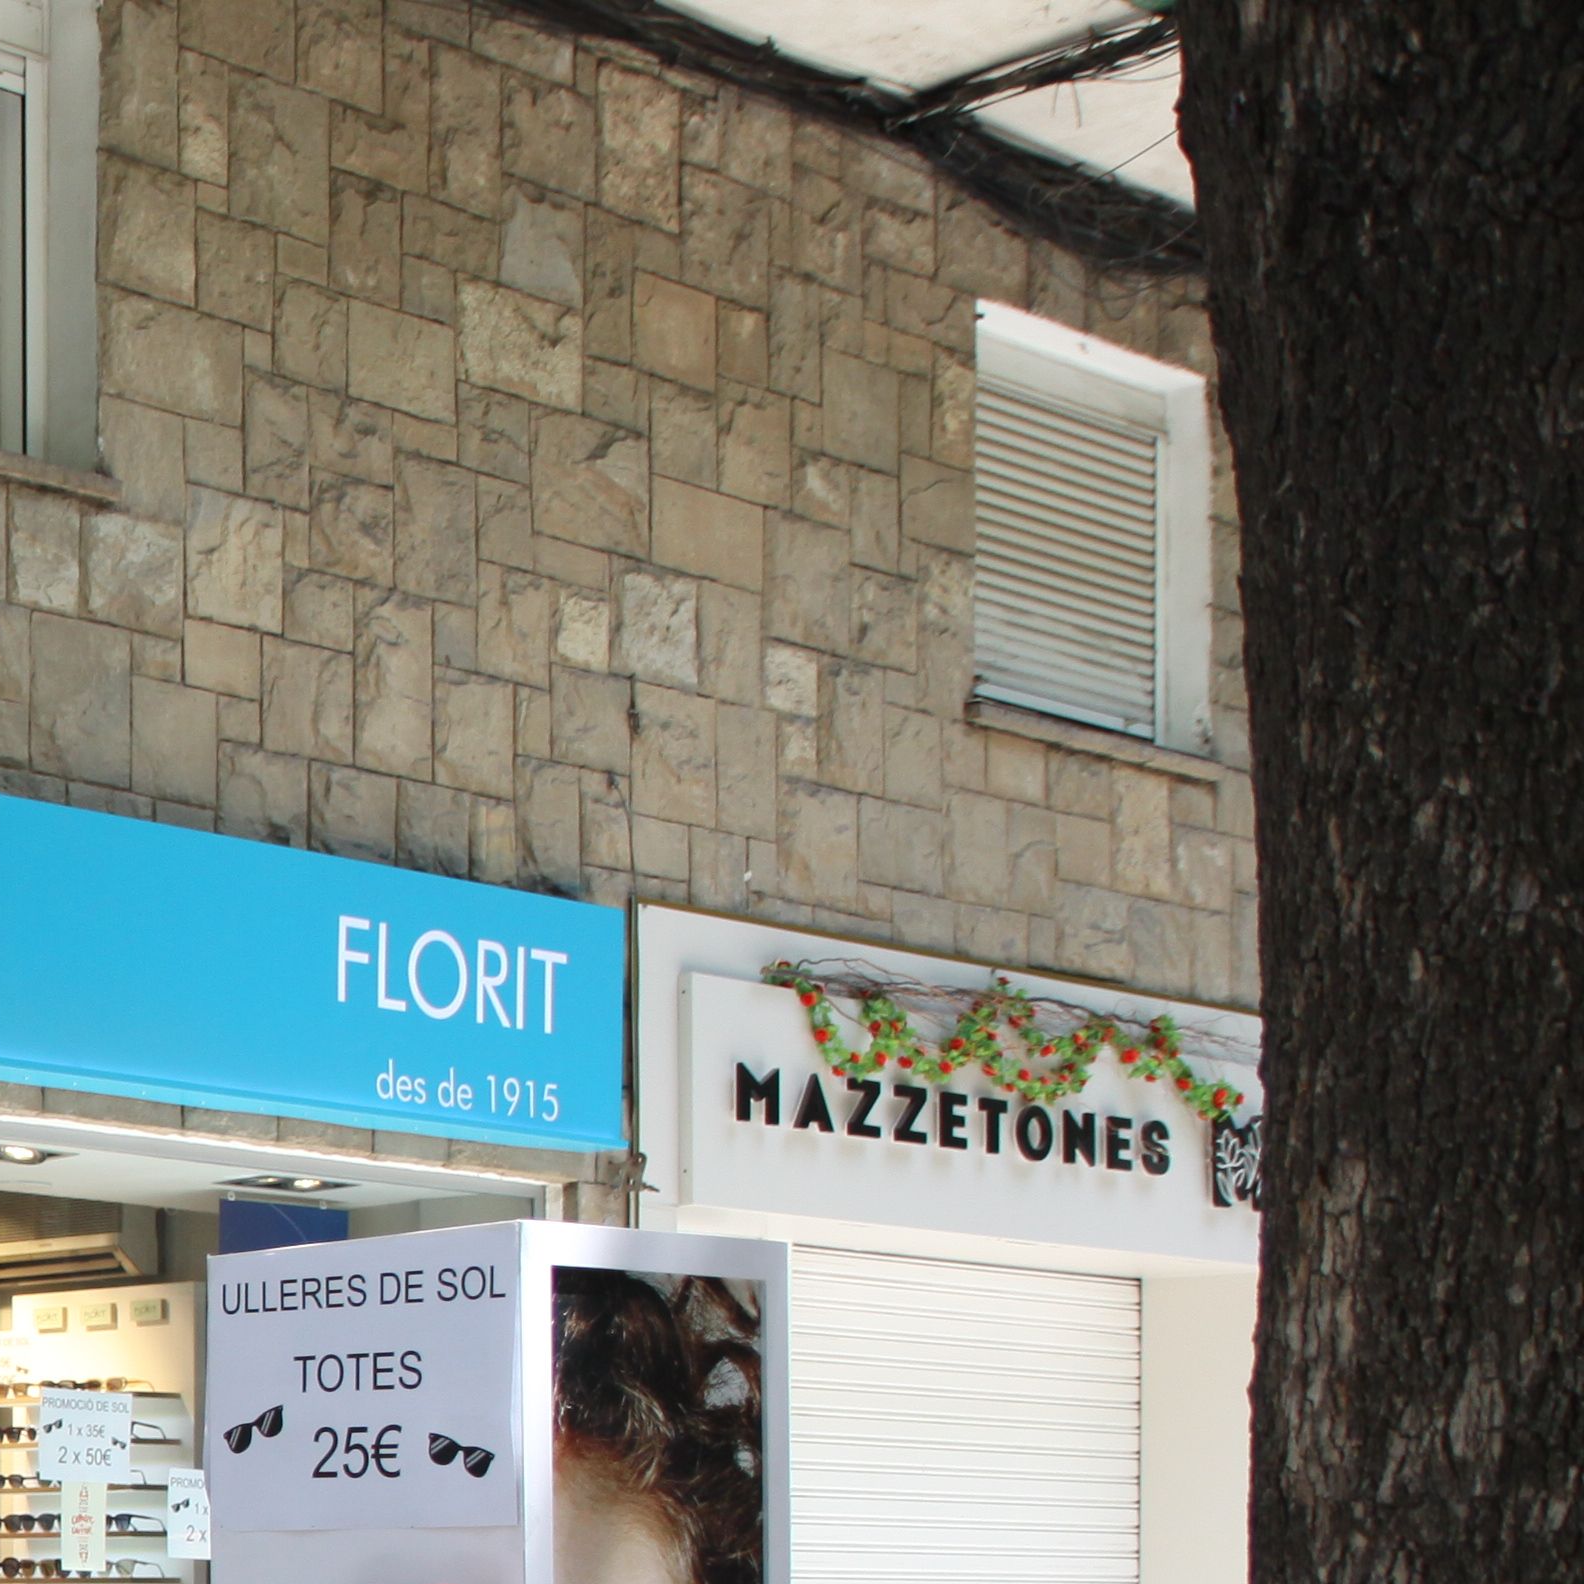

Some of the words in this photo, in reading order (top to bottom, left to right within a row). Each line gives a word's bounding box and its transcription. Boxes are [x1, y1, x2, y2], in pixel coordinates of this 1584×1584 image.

[337, 915, 569, 1034] FLORIT
[376, 1058, 427, 1104] des
[437, 1066, 473, 1110] de
[486, 1074, 561, 1122] 1915
[735, 1061, 1172, 1176] MAZZETONES
[221, 1273, 368, 1315] ULLERES
[379, 1270, 425, 1306] DE
[436, 1265, 507, 1302] SOL
[293, 1350, 423, 1393] TOTES
[42, 1397, 94, 1411] PROMOCIÓ
[96, 1400, 109, 1412] DE
[112, 1402, 130, 1413] SOL
[68, 1423, 73, 1436] 1
[86, 1424, 105, 1438] 35€
[311, 1424, 403, 1479] 25€
[58, 1446, 68, 1463] 2
[72, 1451, 81, 1464] x
[86, 1448, 112, 1466] 50€
[171, 1476, 205, 1489] PROMO
[186, 1525, 195, 1542] 2
